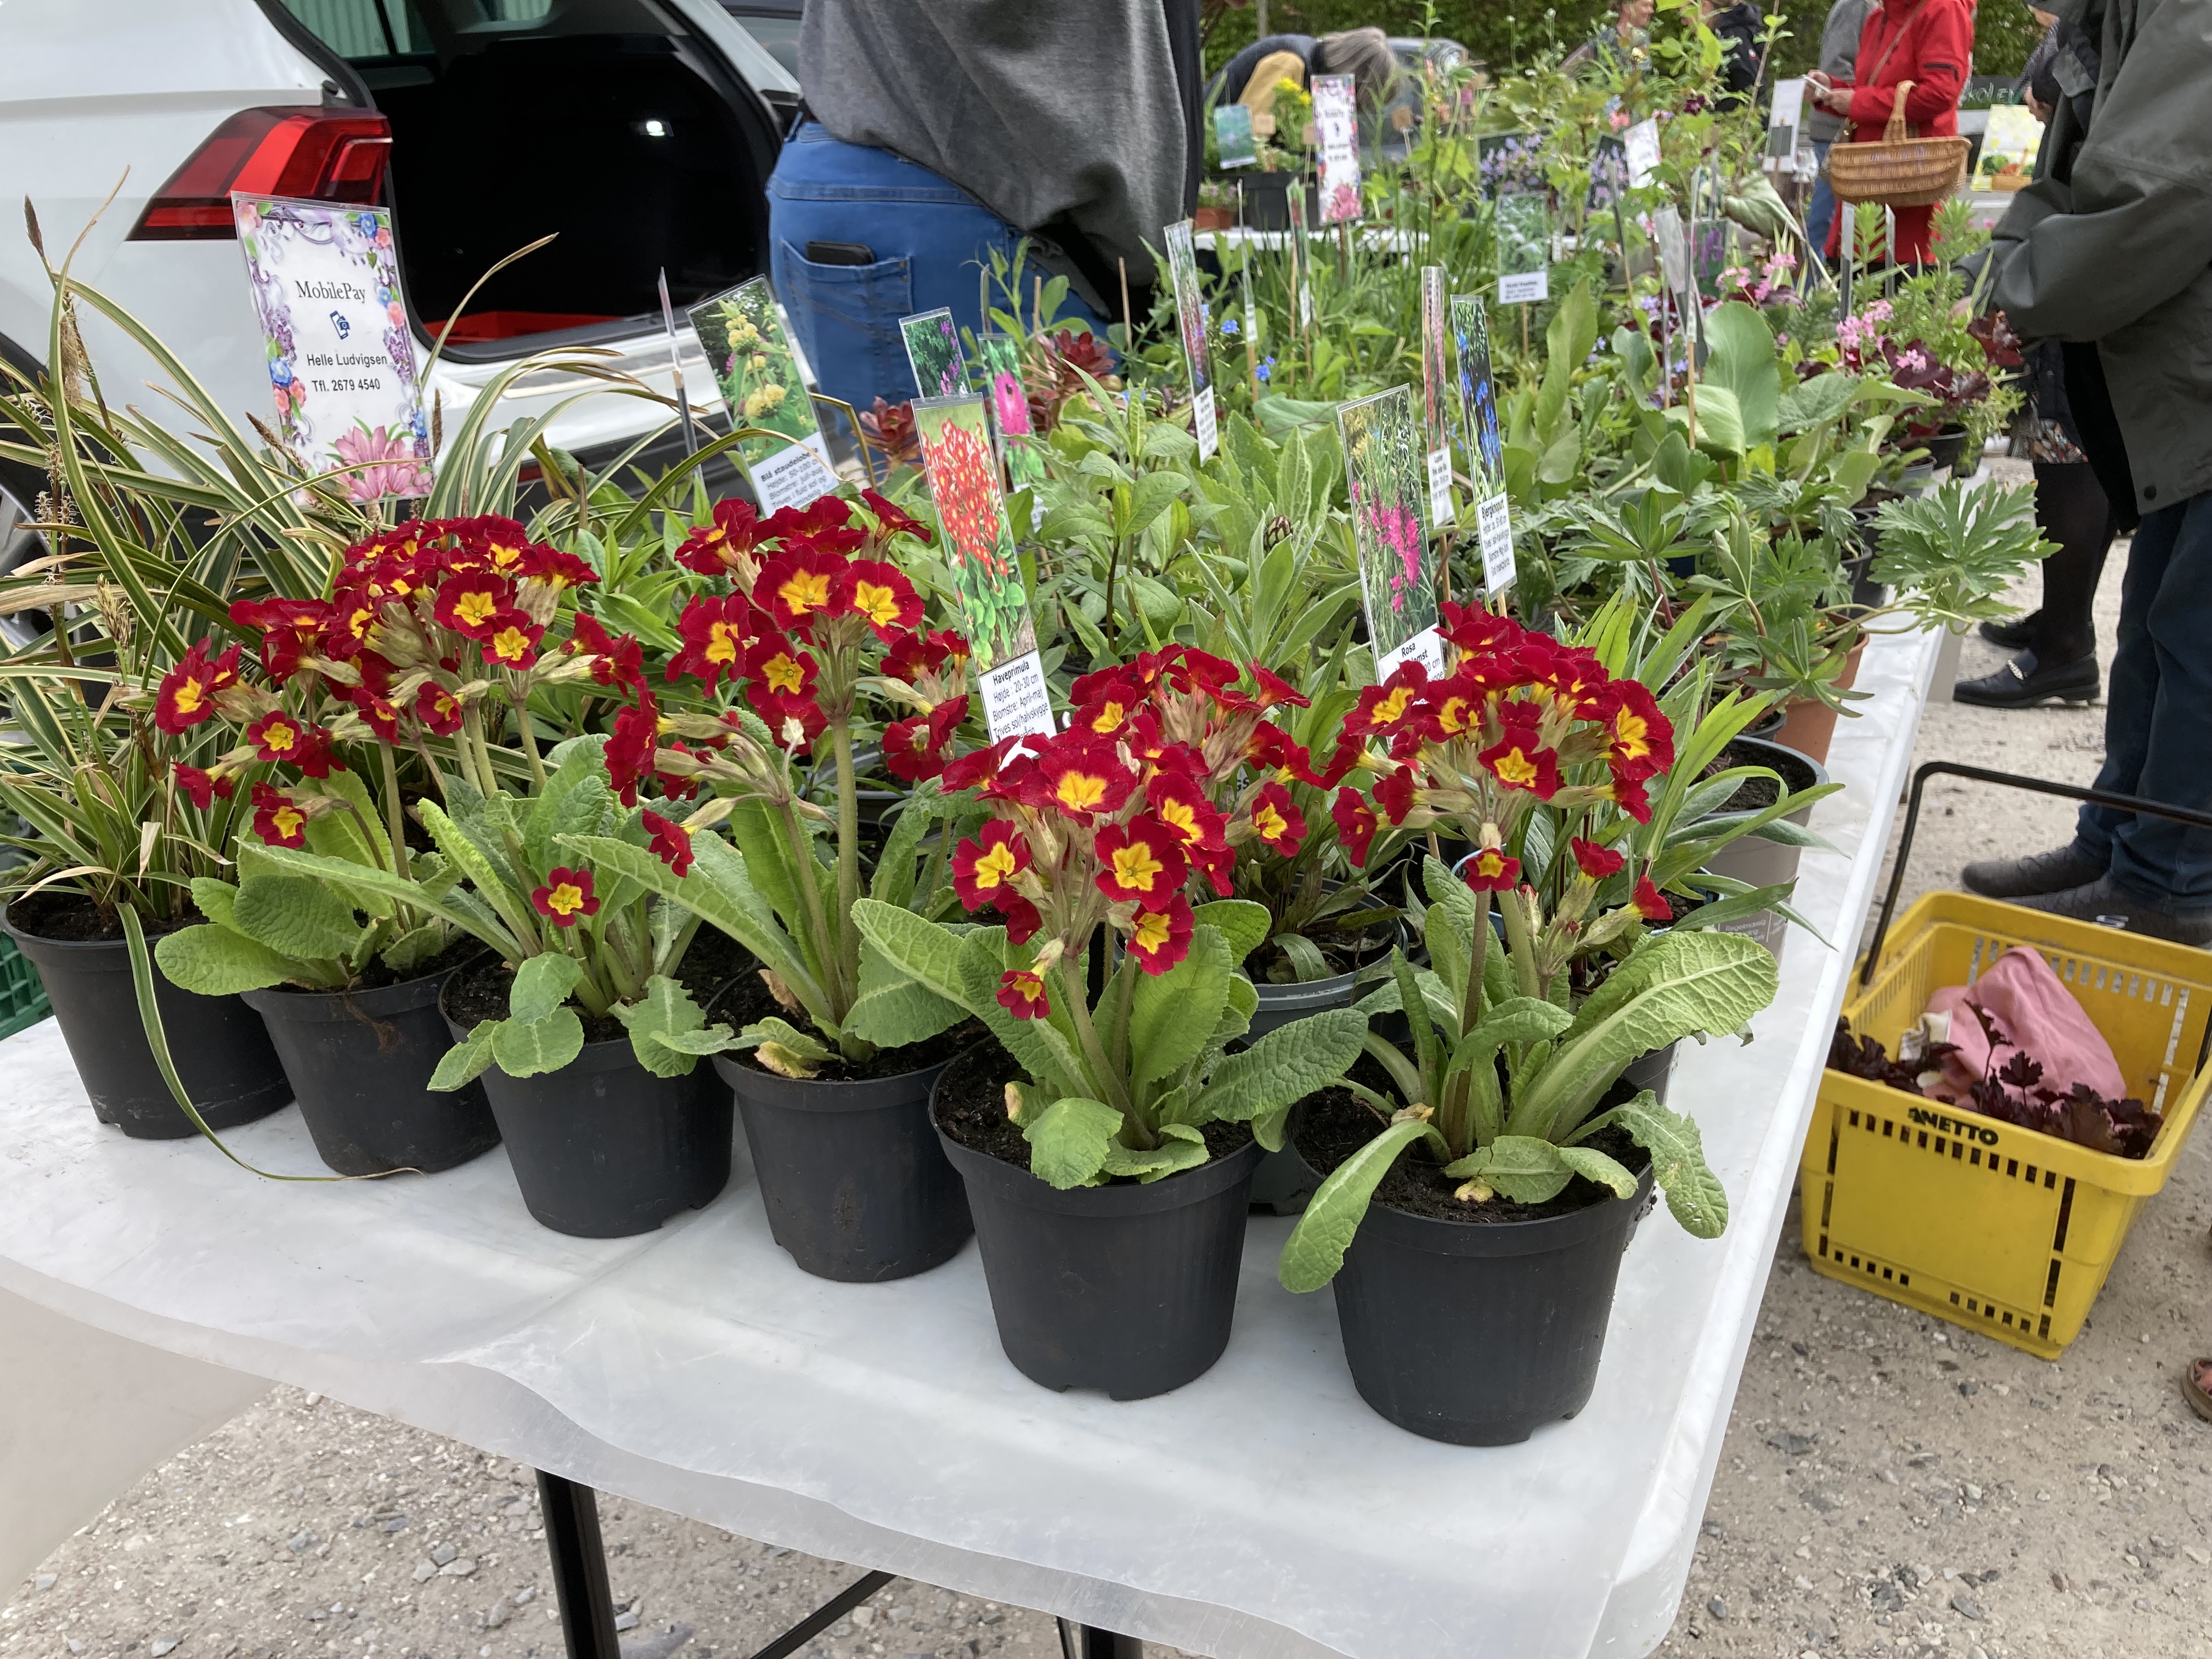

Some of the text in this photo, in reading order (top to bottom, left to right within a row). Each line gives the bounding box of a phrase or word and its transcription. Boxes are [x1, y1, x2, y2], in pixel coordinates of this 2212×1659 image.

[295, 280, 365, 303] MobilePay
[307, 354, 387, 368] Helle Ludvigsen
[312, 379, 380, 392] Tfl. 2679 4540
[775, 447, 819, 475] staudelobeia
[1401, 642, 1416, 658] Rosa
[992, 660, 1030, 686] Haveprimula
[1432, 658, 1441, 669] cm
[994, 688, 1010, 704] Højde
[1014, 677, 1030, 693] 20-30
[1030, 673, 1039, 685] cm
[992, 688, 1043, 723] Blomstre: April-maj
[994, 702, 1048, 739] Trives sol/halvskygge
[1920, 1109, 1999, 1146] NETTO
